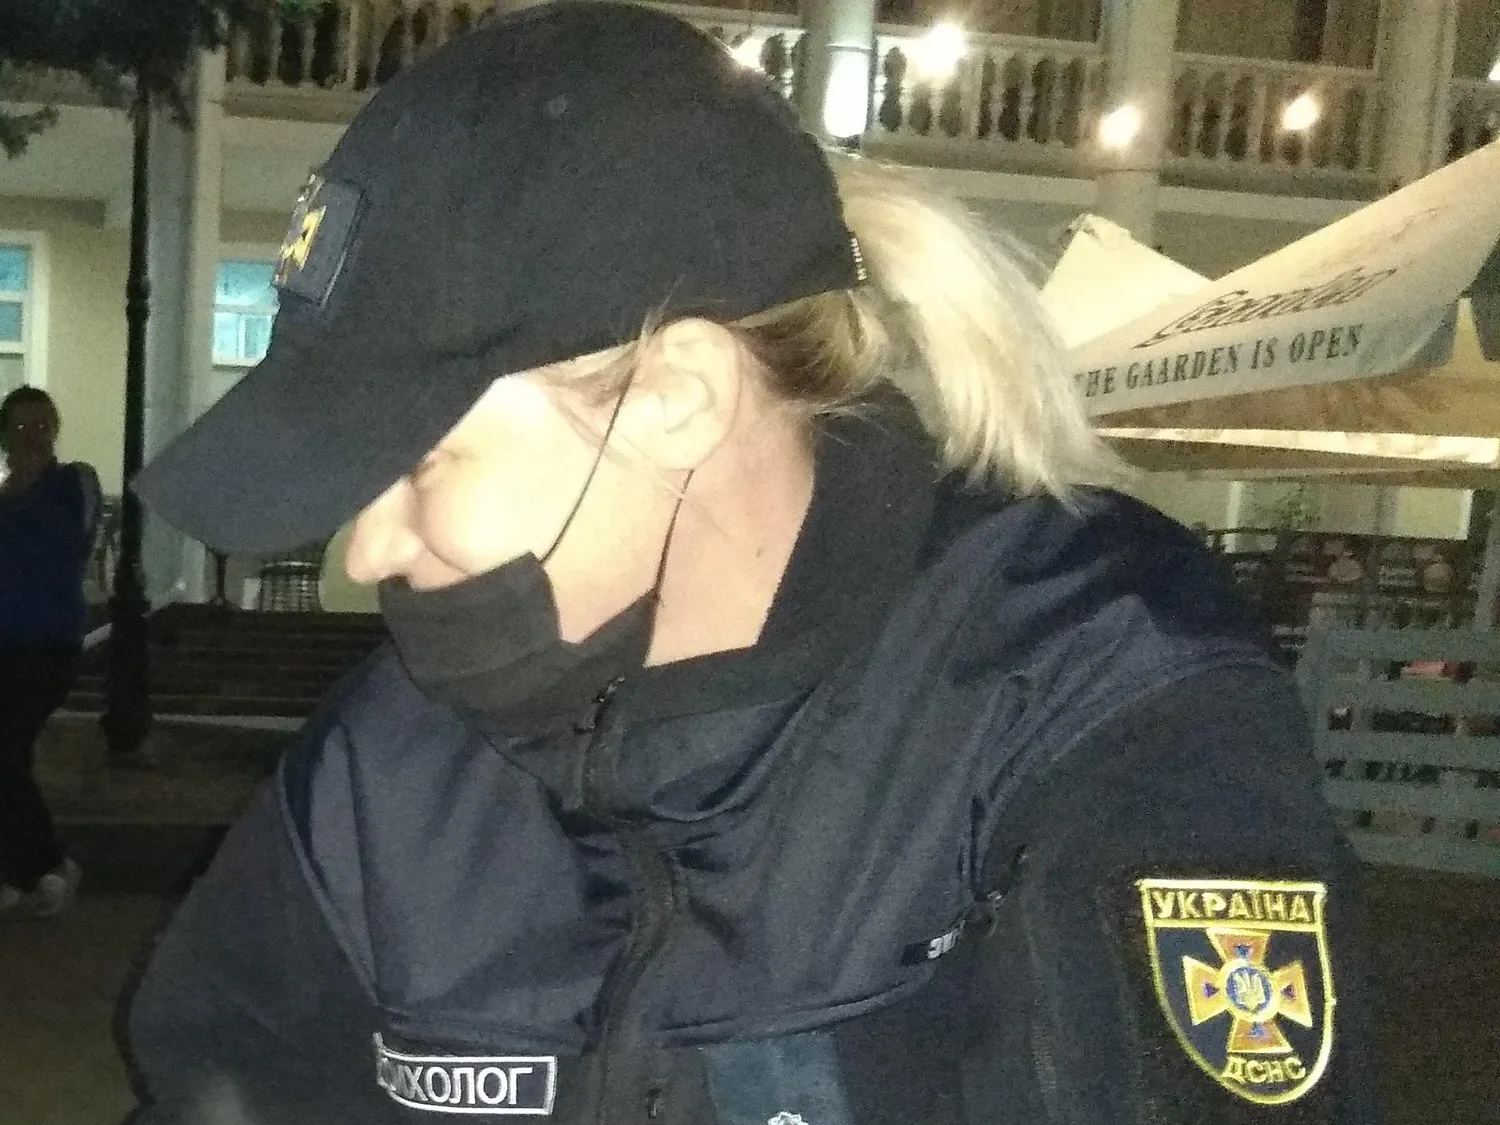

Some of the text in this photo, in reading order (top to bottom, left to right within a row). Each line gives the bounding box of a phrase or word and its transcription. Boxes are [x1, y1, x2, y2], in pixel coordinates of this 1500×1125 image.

[1127, 345, 1239, 389] GAARDEN
[1250, 337, 1279, 370] IS
[1289, 324, 1364, 363] OPEN
[1151, 889, 1315, 923] УКРАЇНА
[1221, 1056, 1307, 1084] ДСНС
